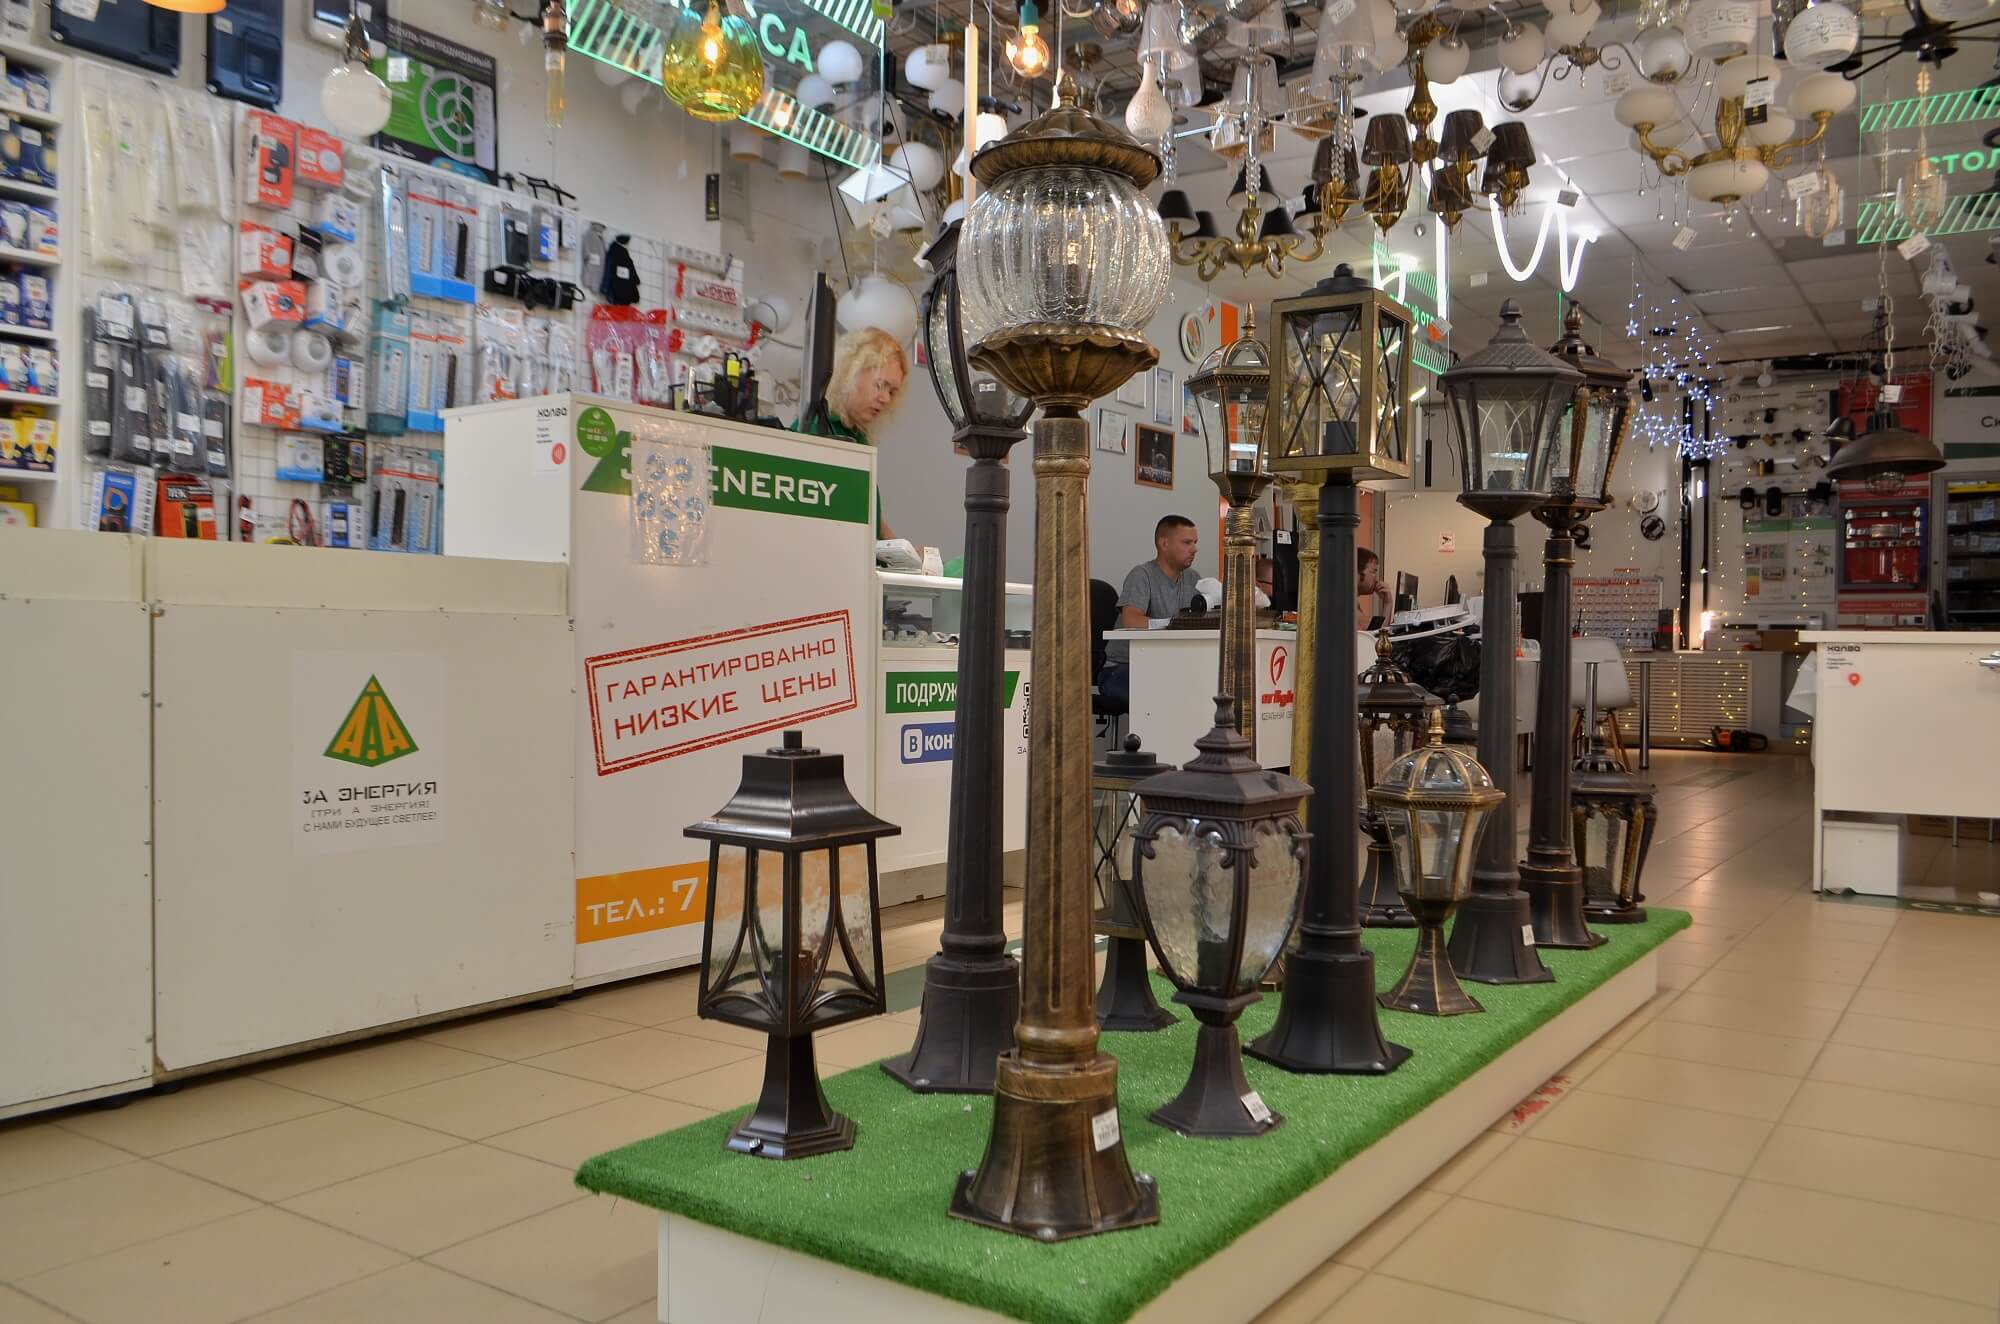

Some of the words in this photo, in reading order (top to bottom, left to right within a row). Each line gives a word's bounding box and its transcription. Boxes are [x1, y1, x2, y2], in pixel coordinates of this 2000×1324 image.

[607, 638, 836, 702] ГАРАНТИРОВАННО
[614, 691, 739, 739] НИЗКИЕ
[762, 668, 837, 703] ЦЕНЫ
[338, 781, 437, 801] ЭНЕРГИЯ
[313, 820, 343, 831] НАМИ
[345, 815, 391, 829] БУДУЩЕЕ
